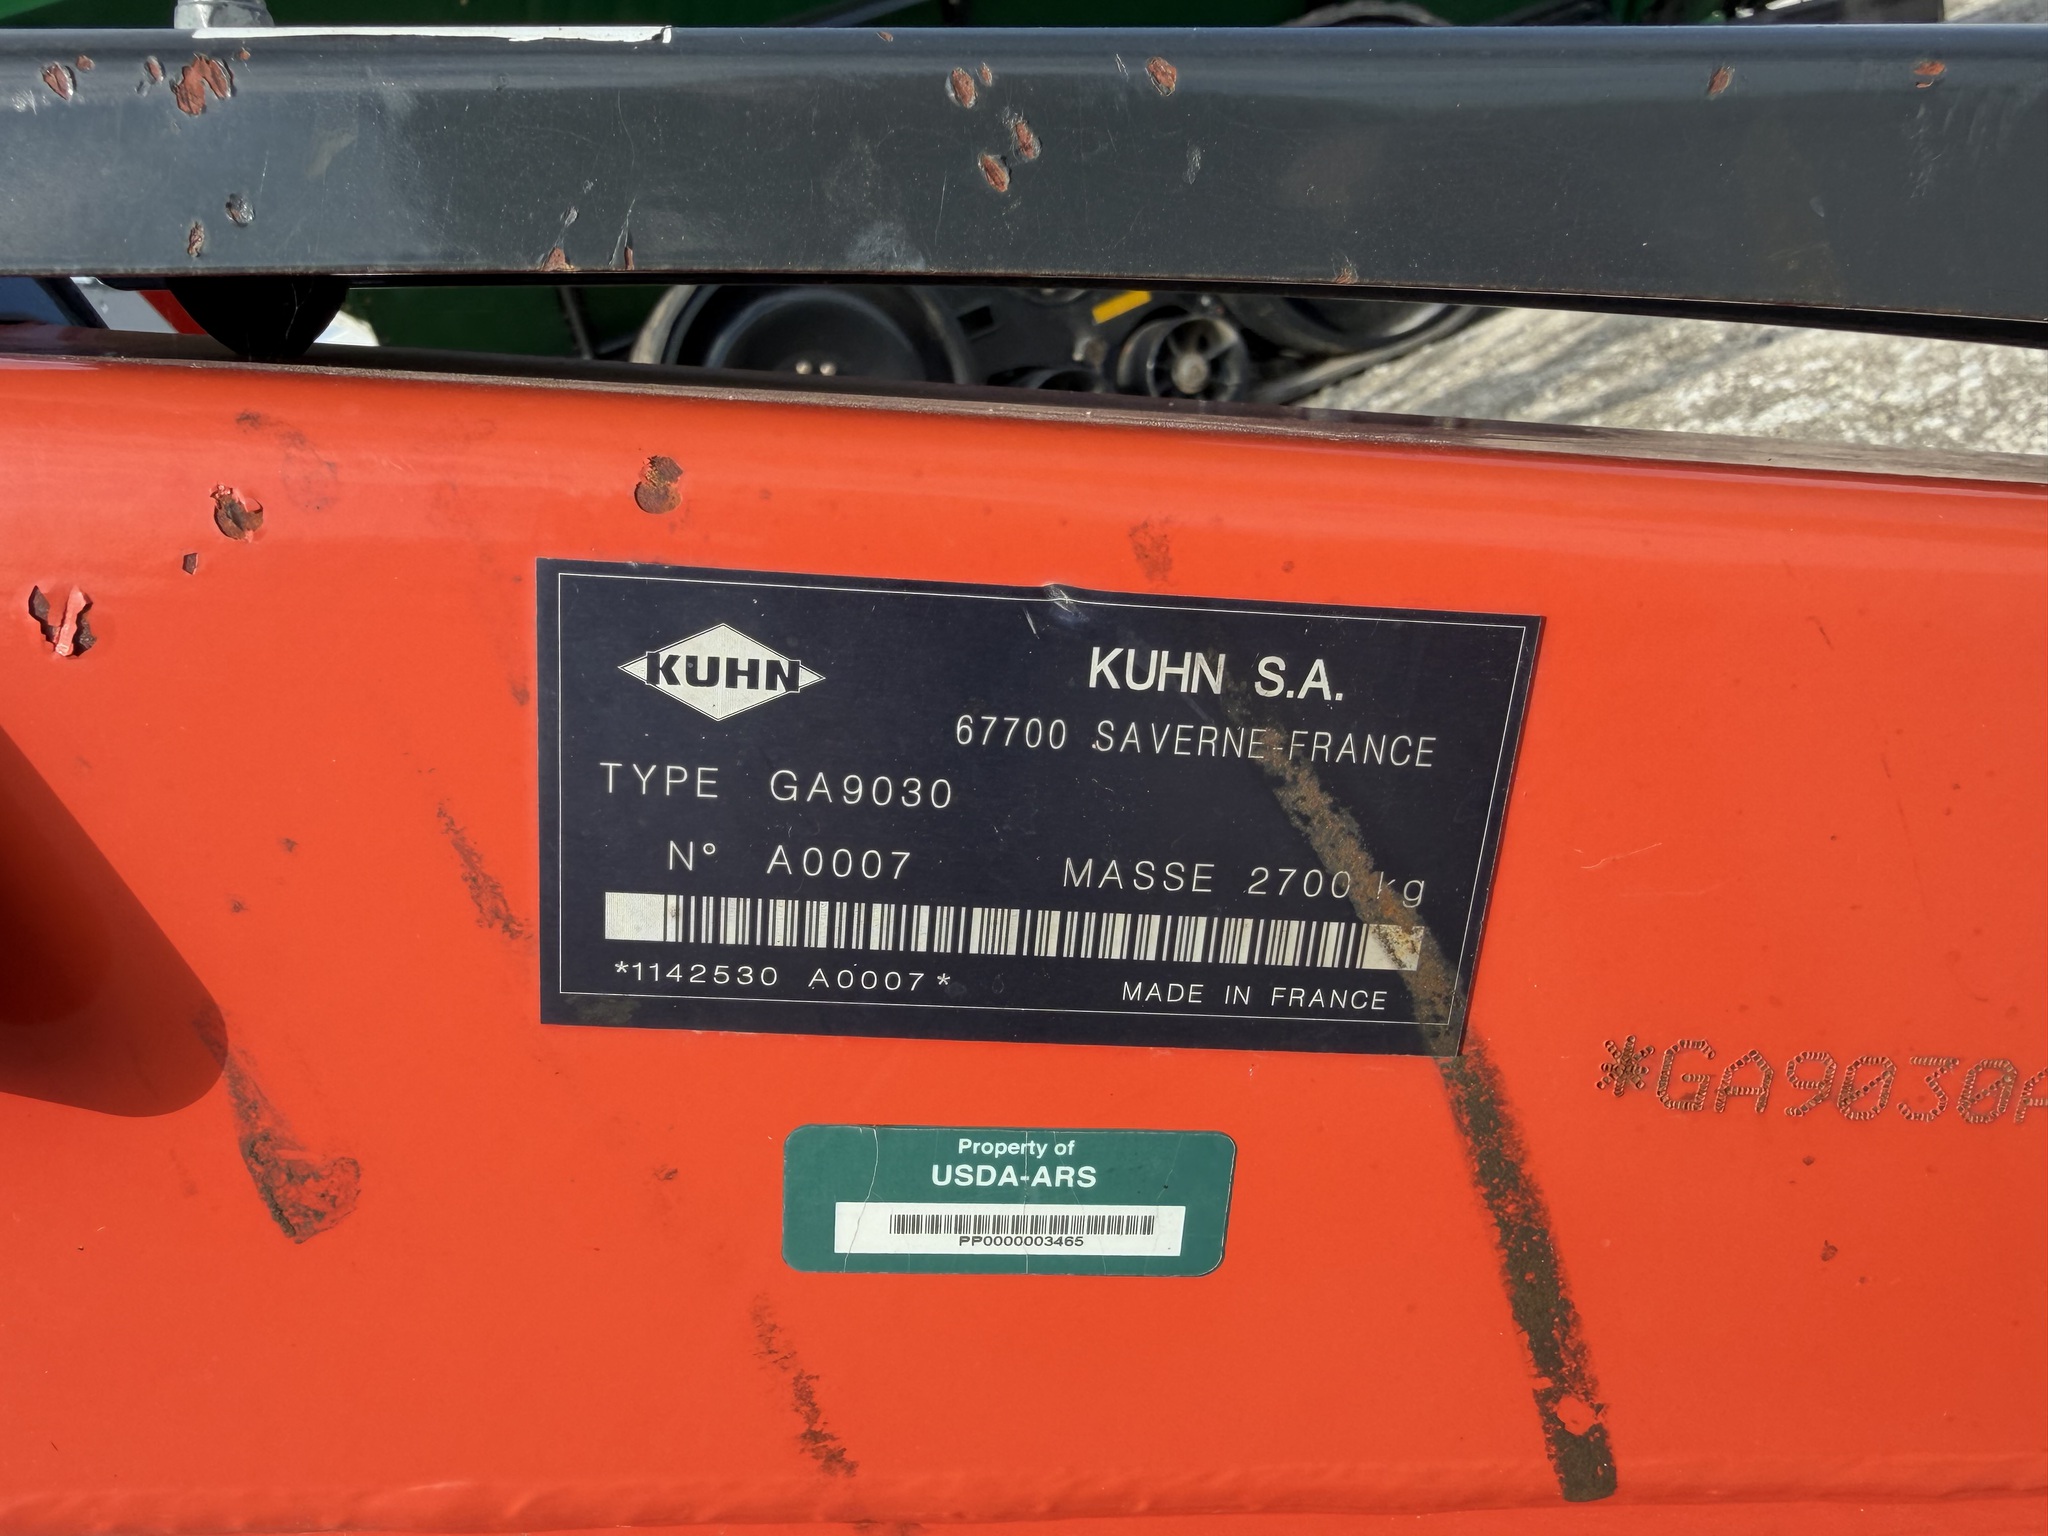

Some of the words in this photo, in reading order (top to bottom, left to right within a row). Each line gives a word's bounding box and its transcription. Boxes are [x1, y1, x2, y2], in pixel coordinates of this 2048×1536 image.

[646, 652, 800, 693] KUHN
[1088, 647, 1226, 695] KUHN
[1254, 656, 1343, 701] S.A.
[955, 714, 1067, 750] 67700
[600, 762, 719, 798] TYPE
[770, 769, 952, 808] GA9030
[667, 840, 716, 872] N°
[766, 844, 911, 880] A0007
[1063, 856, 1215, 894] MASSE
[1248, 866, 1352, 900] 2700
[1121, 979, 1203, 1004] MADE
[1224, 983, 1250, 1005] IN
[1271, 985, 1388, 1011] FRANCE
[958, 1139, 1047, 1159] Property
[1054, 1140, 1075, 1156] of
[931, 1164, 1097, 1188] USDA-ARS
[958, 1235, 1084, 1247] PP0000003465
